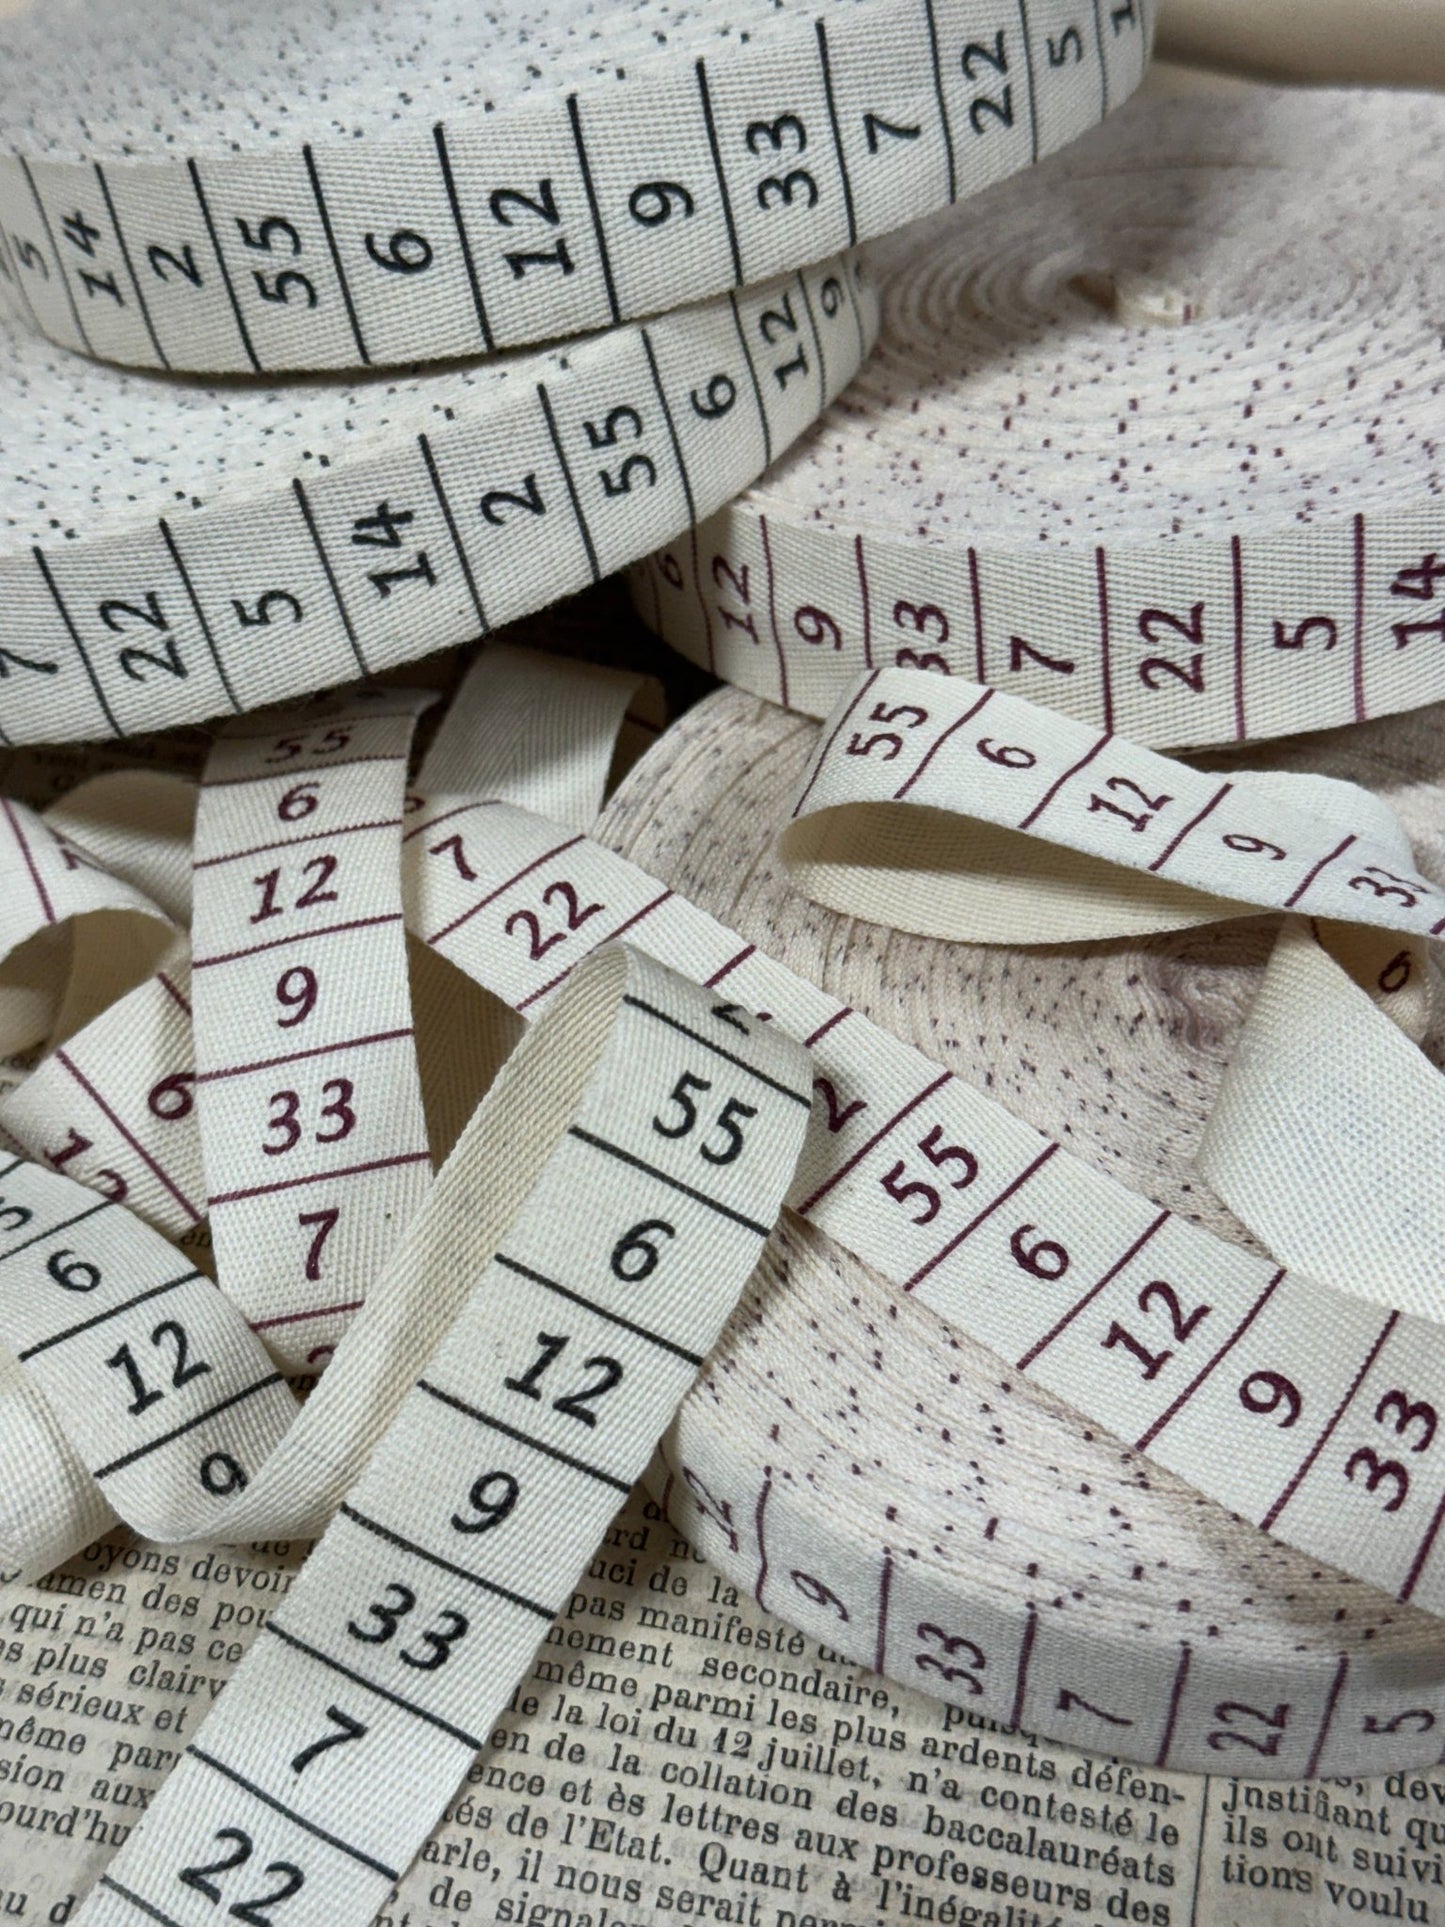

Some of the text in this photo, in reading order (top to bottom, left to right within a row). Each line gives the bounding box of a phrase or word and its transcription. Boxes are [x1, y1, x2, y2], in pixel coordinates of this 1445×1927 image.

[1047, 26, 1083, 67] 5
[961, 30, 1014, 135] 22
[745, 111, 819, 209] 33
[863, 113, 921, 154] 7
[489, 179, 575, 279] 12
[629, 181, 694, 227] 9
[62, 210, 126, 307] 14
[147, 245, 203, 287] 2
[236, 216, 318, 308] 55
[364, 229, 433, 274] 6
[759, 294, 809, 391] 12
[690, 374, 737, 420] 6
[582, 405, 657, 497] 55
[479, 473, 546, 526] 2
[351, 500, 437, 598] 14
[230, 590, 303, 627] 5
[712, 554, 760, 645] 12
[794, 605, 842, 651] 9
[99, 591, 189, 681] 22
[1009, 636, 1075, 674] 7
[1137, 602, 1205, 693] 22
[1273, 616, 1338, 650] 5
[264, 725, 355, 764] 55
[847, 701, 929, 761] 55
[977, 738, 1036, 769] 6
[277, 782, 320, 821] 6
[1087, 777, 1173, 832] 12
[428, 834, 477, 881] 7
[1222, 834, 1287, 860] 9
[249, 854, 338, 924] 12
[505, 881, 605, 961] 22
[276, 966, 318, 1028] 9
[149, 1072, 194, 1120] 6
[263, 1078, 356, 1156] 33
[652, 1069, 758, 1166] 55
[880, 1124, 979, 1225] 55
[46, 1249, 101, 1292] 6
[299, 1208, 339, 1281] 7
[611, 1219, 675, 1282] 6
[1010, 1224, 1069, 1281] 6
[1100, 1280, 1212, 1381] 12
[105, 1319, 212, 1416] 12
[506, 1335, 621, 1425] 12
[1239, 1371, 1302, 1428] 9
[1345, 1389, 1437, 1512] 33
[451, 1471, 519, 1534] 9
[27, 1571, 127, 1605] amen
[141, 1582, 201, 1618] des
[648, 1564, 688, 1597] de
[706, 1575, 740, 1608] la
[790, 1570, 849, 1622] 9
[10, 1602, 244, 1664] qui n'a pas ce
[347, 1583, 470, 1671] 33
[566, 1592, 626, 1620] pas
[637, 1605, 805, 1656] manifesté
[32, 1642, 109, 1676] plus
[698, 1656, 900, 1720] secondaire,
[915, 1623, 986, 1695] 33
[16, 1680, 189, 1734] sérieux et
[533, 1659, 1186, 1806] même parmi les plus ardents défen-
[1056, 1689, 1133, 1726] 7
[1207, 1701, 1290, 1757] 22
[1363, 1710, 1436, 1734] 5
[291, 1705, 368, 1774] 7
[551, 1693, 584, 1726] la
[596, 1701, 643, 1737] loi
[653, 1715, 698, 1749] du
[712, 1726, 752, 1759] 12
[757, 1736, 882, 1790] juillet,
[906, 1766, 962, 1801] n'a
[980, 1784, 1134, 1837] contesté
[1145, 1812, 1180, 1847] le
[491, 1727, 1176, 1888] en de la collation des baccalauréats
[1222, 1814, 1268, 1849] ils
[1282, 1829, 1339, 1864] ont
[179, 1827, 305, 1927] 22
[421, 1838, 501, 1883] arle,
[517, 1847, 544, 1883] il
[553, 1863, 643, 1904] nous
[654, 1884, 761, 1927] serait
[506, 1804, 549, 1840] de
[559, 1812, 672, 1867] l'Etat.
[699, 1841, 809, 1894] Quant
[831, 1870, 852, 1903] à
[559, 1777, 594, 1807] et
[606, 1782, 646, 1817] ès
[660, 1792, 780, 1846] lettres
[794, 1827, 858, 1862] aux
[870, 1842, 1092, 1913] professeurs
[1106, 1886, 1171, 1926] des
[428, 1875, 473, 1913] de
[1221, 1853, 1430, 1925] tions voulu
